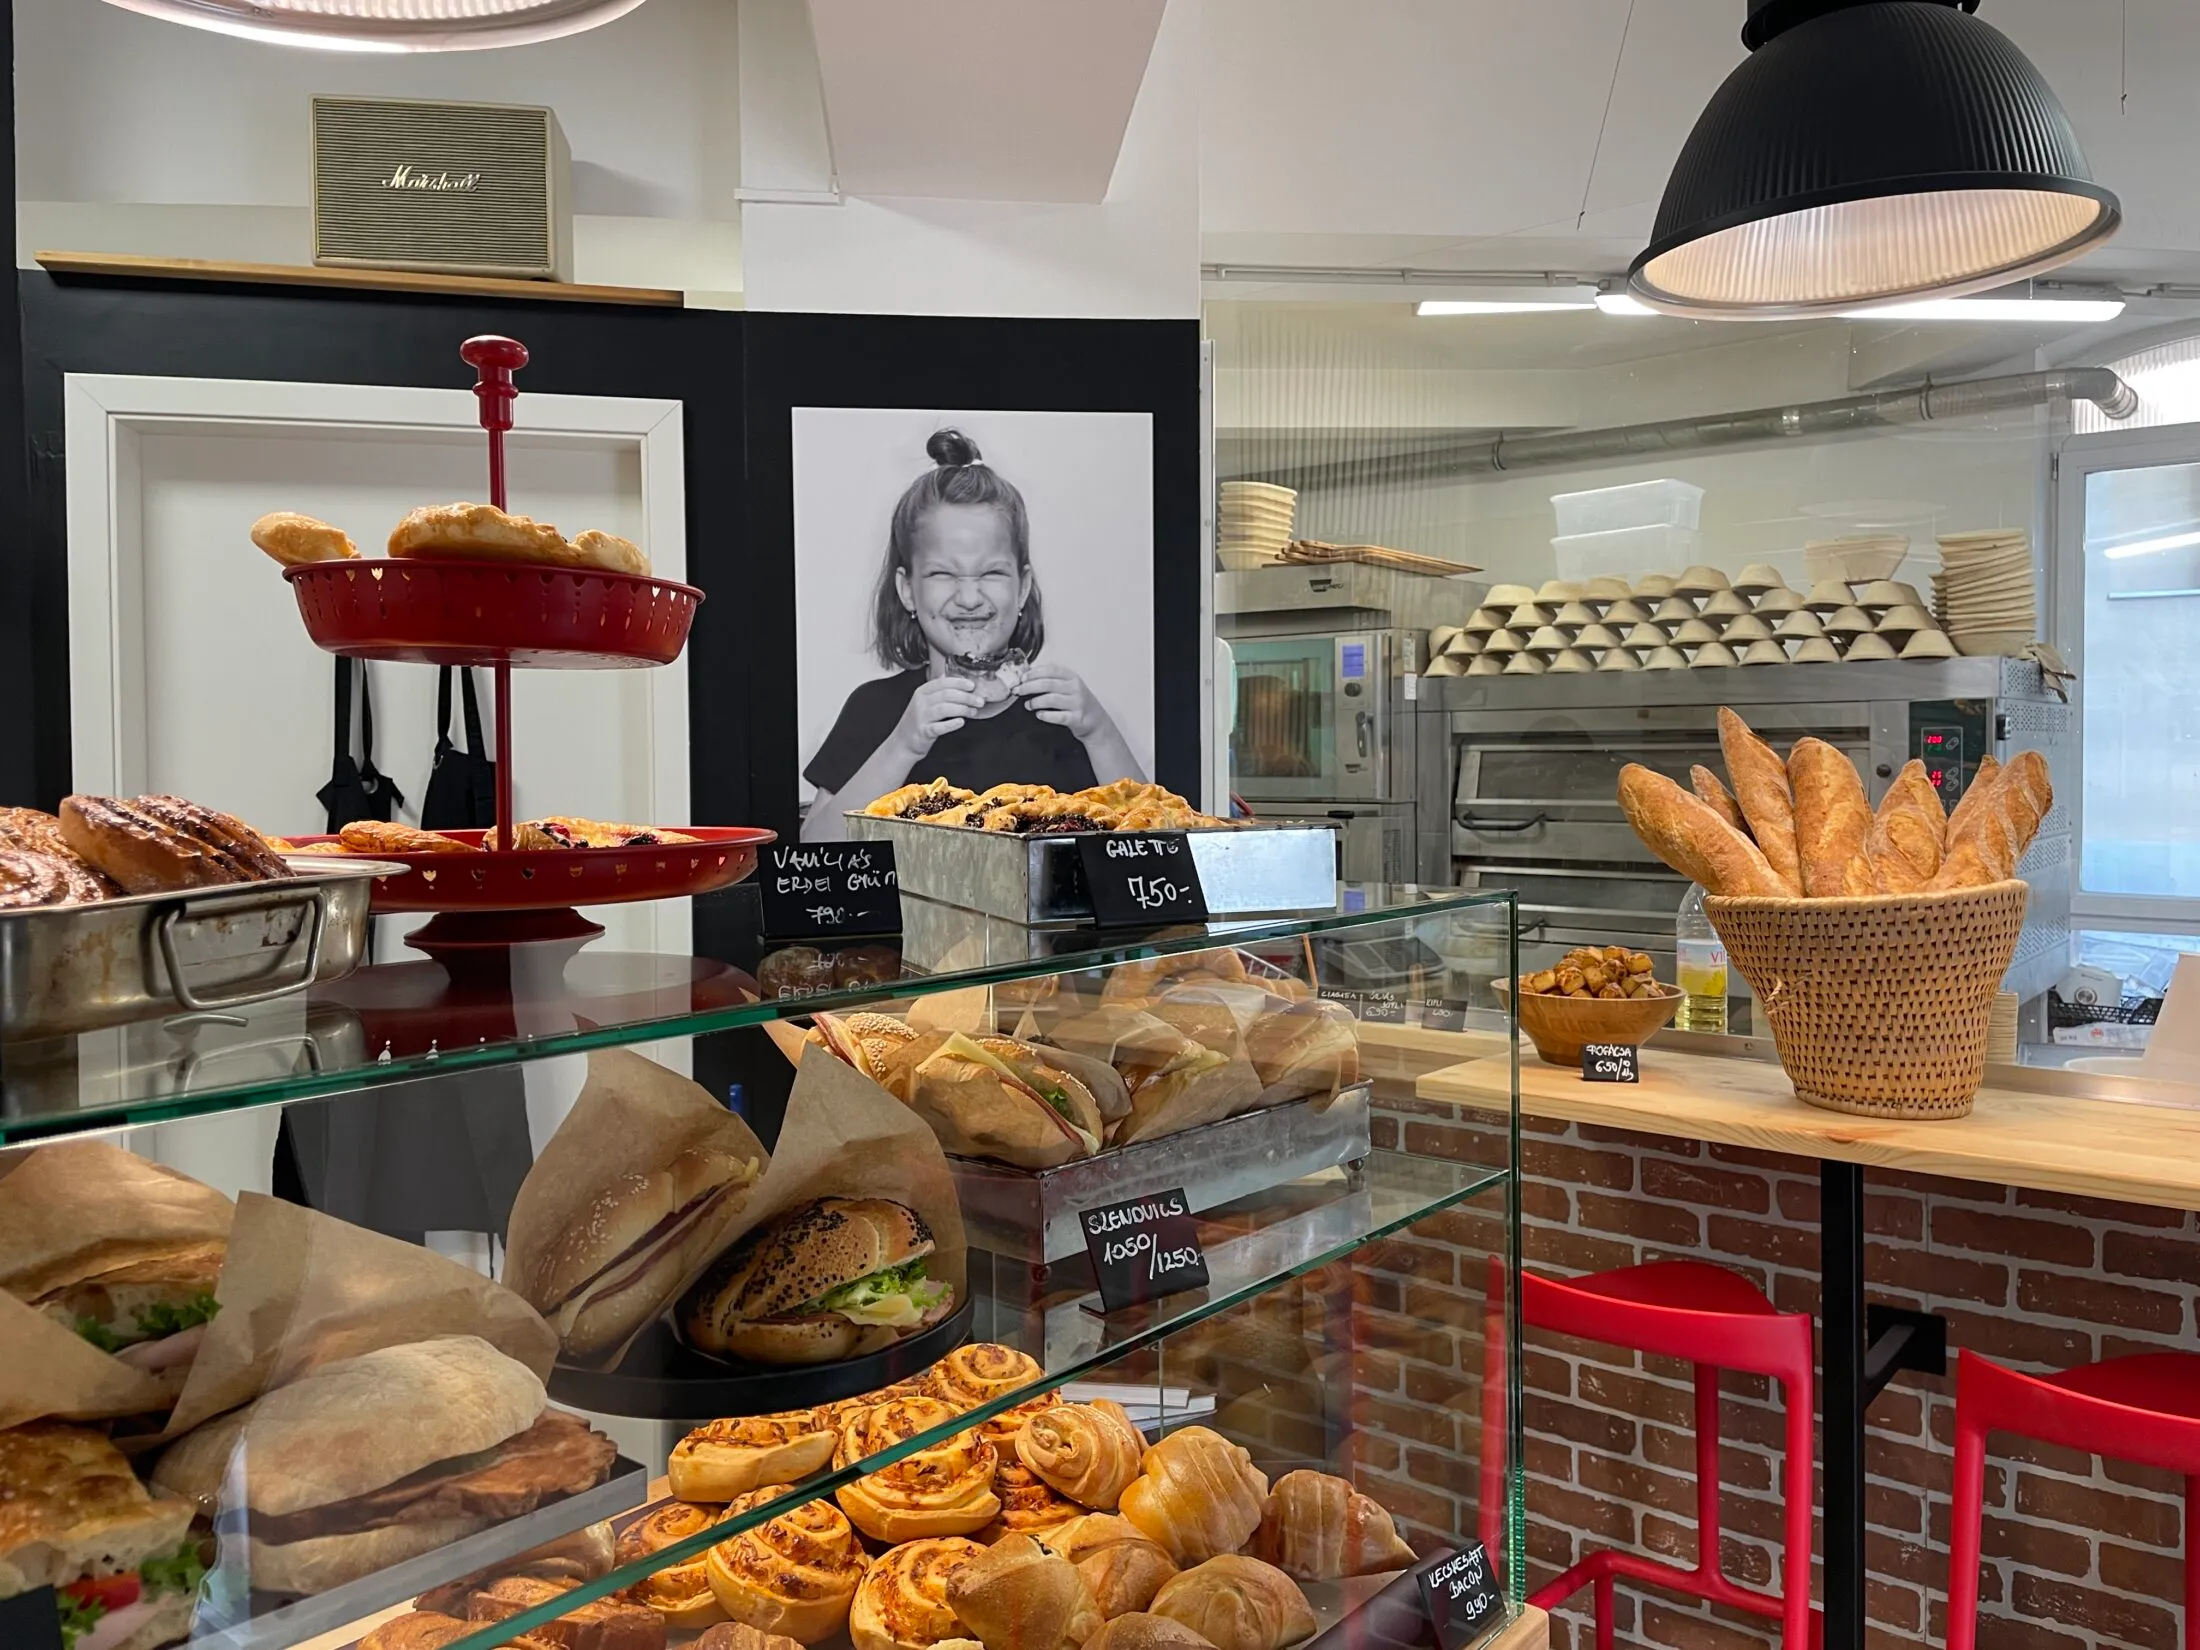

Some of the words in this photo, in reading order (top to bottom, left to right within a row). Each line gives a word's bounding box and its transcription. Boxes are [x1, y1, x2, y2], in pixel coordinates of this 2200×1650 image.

[381, 163, 481, 192] Marshall
[776, 875, 832, 895] ERDEI
[1448, 1564, 1484, 1600] BACON
